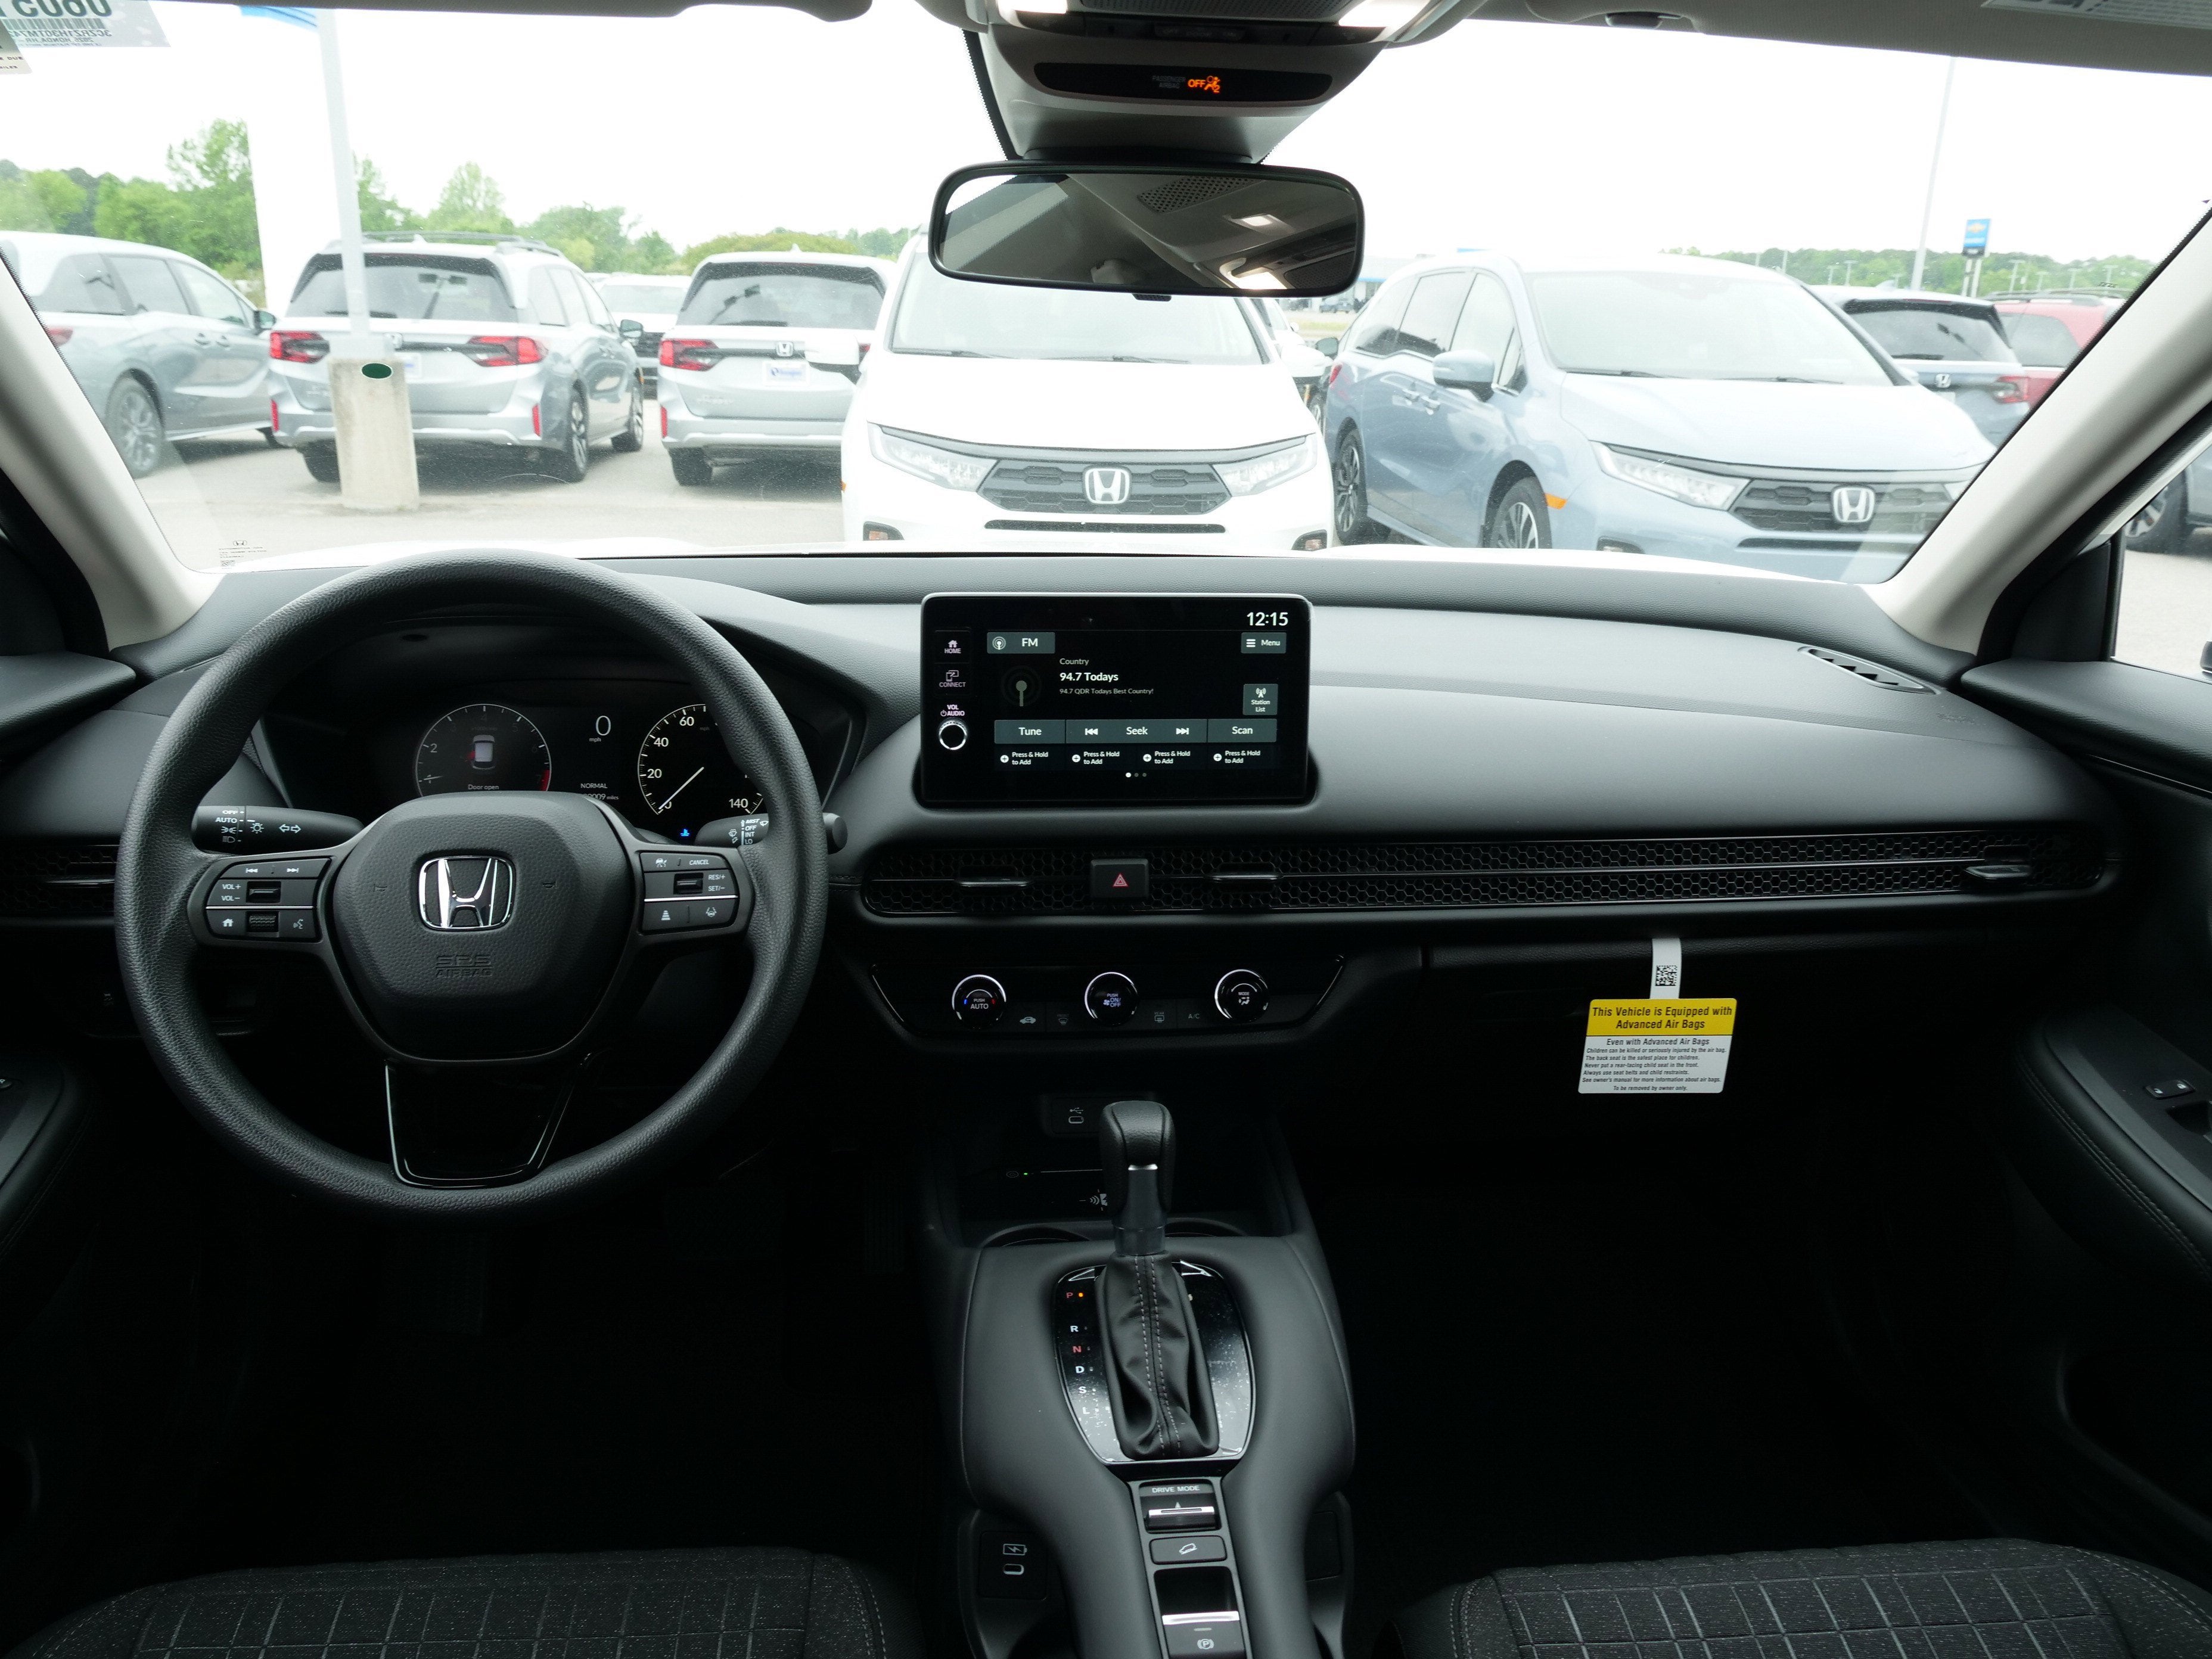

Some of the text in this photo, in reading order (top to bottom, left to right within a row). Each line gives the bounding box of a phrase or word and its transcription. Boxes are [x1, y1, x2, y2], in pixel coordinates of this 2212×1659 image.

[1188, 79, 1206, 88] OFF
[1247, 612, 1289, 626] 12:15
[1021, 638, 1038, 647] FM
[1059, 672, 1119, 682] 94.7 Todays
[595, 715, 611, 736] 0
[679, 716, 694, 726] 60
[1018, 727, 1042, 735] Tune
[1126, 726, 1148, 735] Seek
[1231, 726, 1253, 734] Scan
[653, 737, 669, 747] 40
[430, 744, 438, 753] 2
[647, 768, 662, 779] 20
[728, 798, 748, 808] 140
[436, 953, 491, 966] SRS
[435, 968, 493, 978] AIRBAG
[1592, 1006, 1732, 1017] This Vehicle is Equipped with
[1615, 1020, 1705, 1030] Advanced Air Bags
